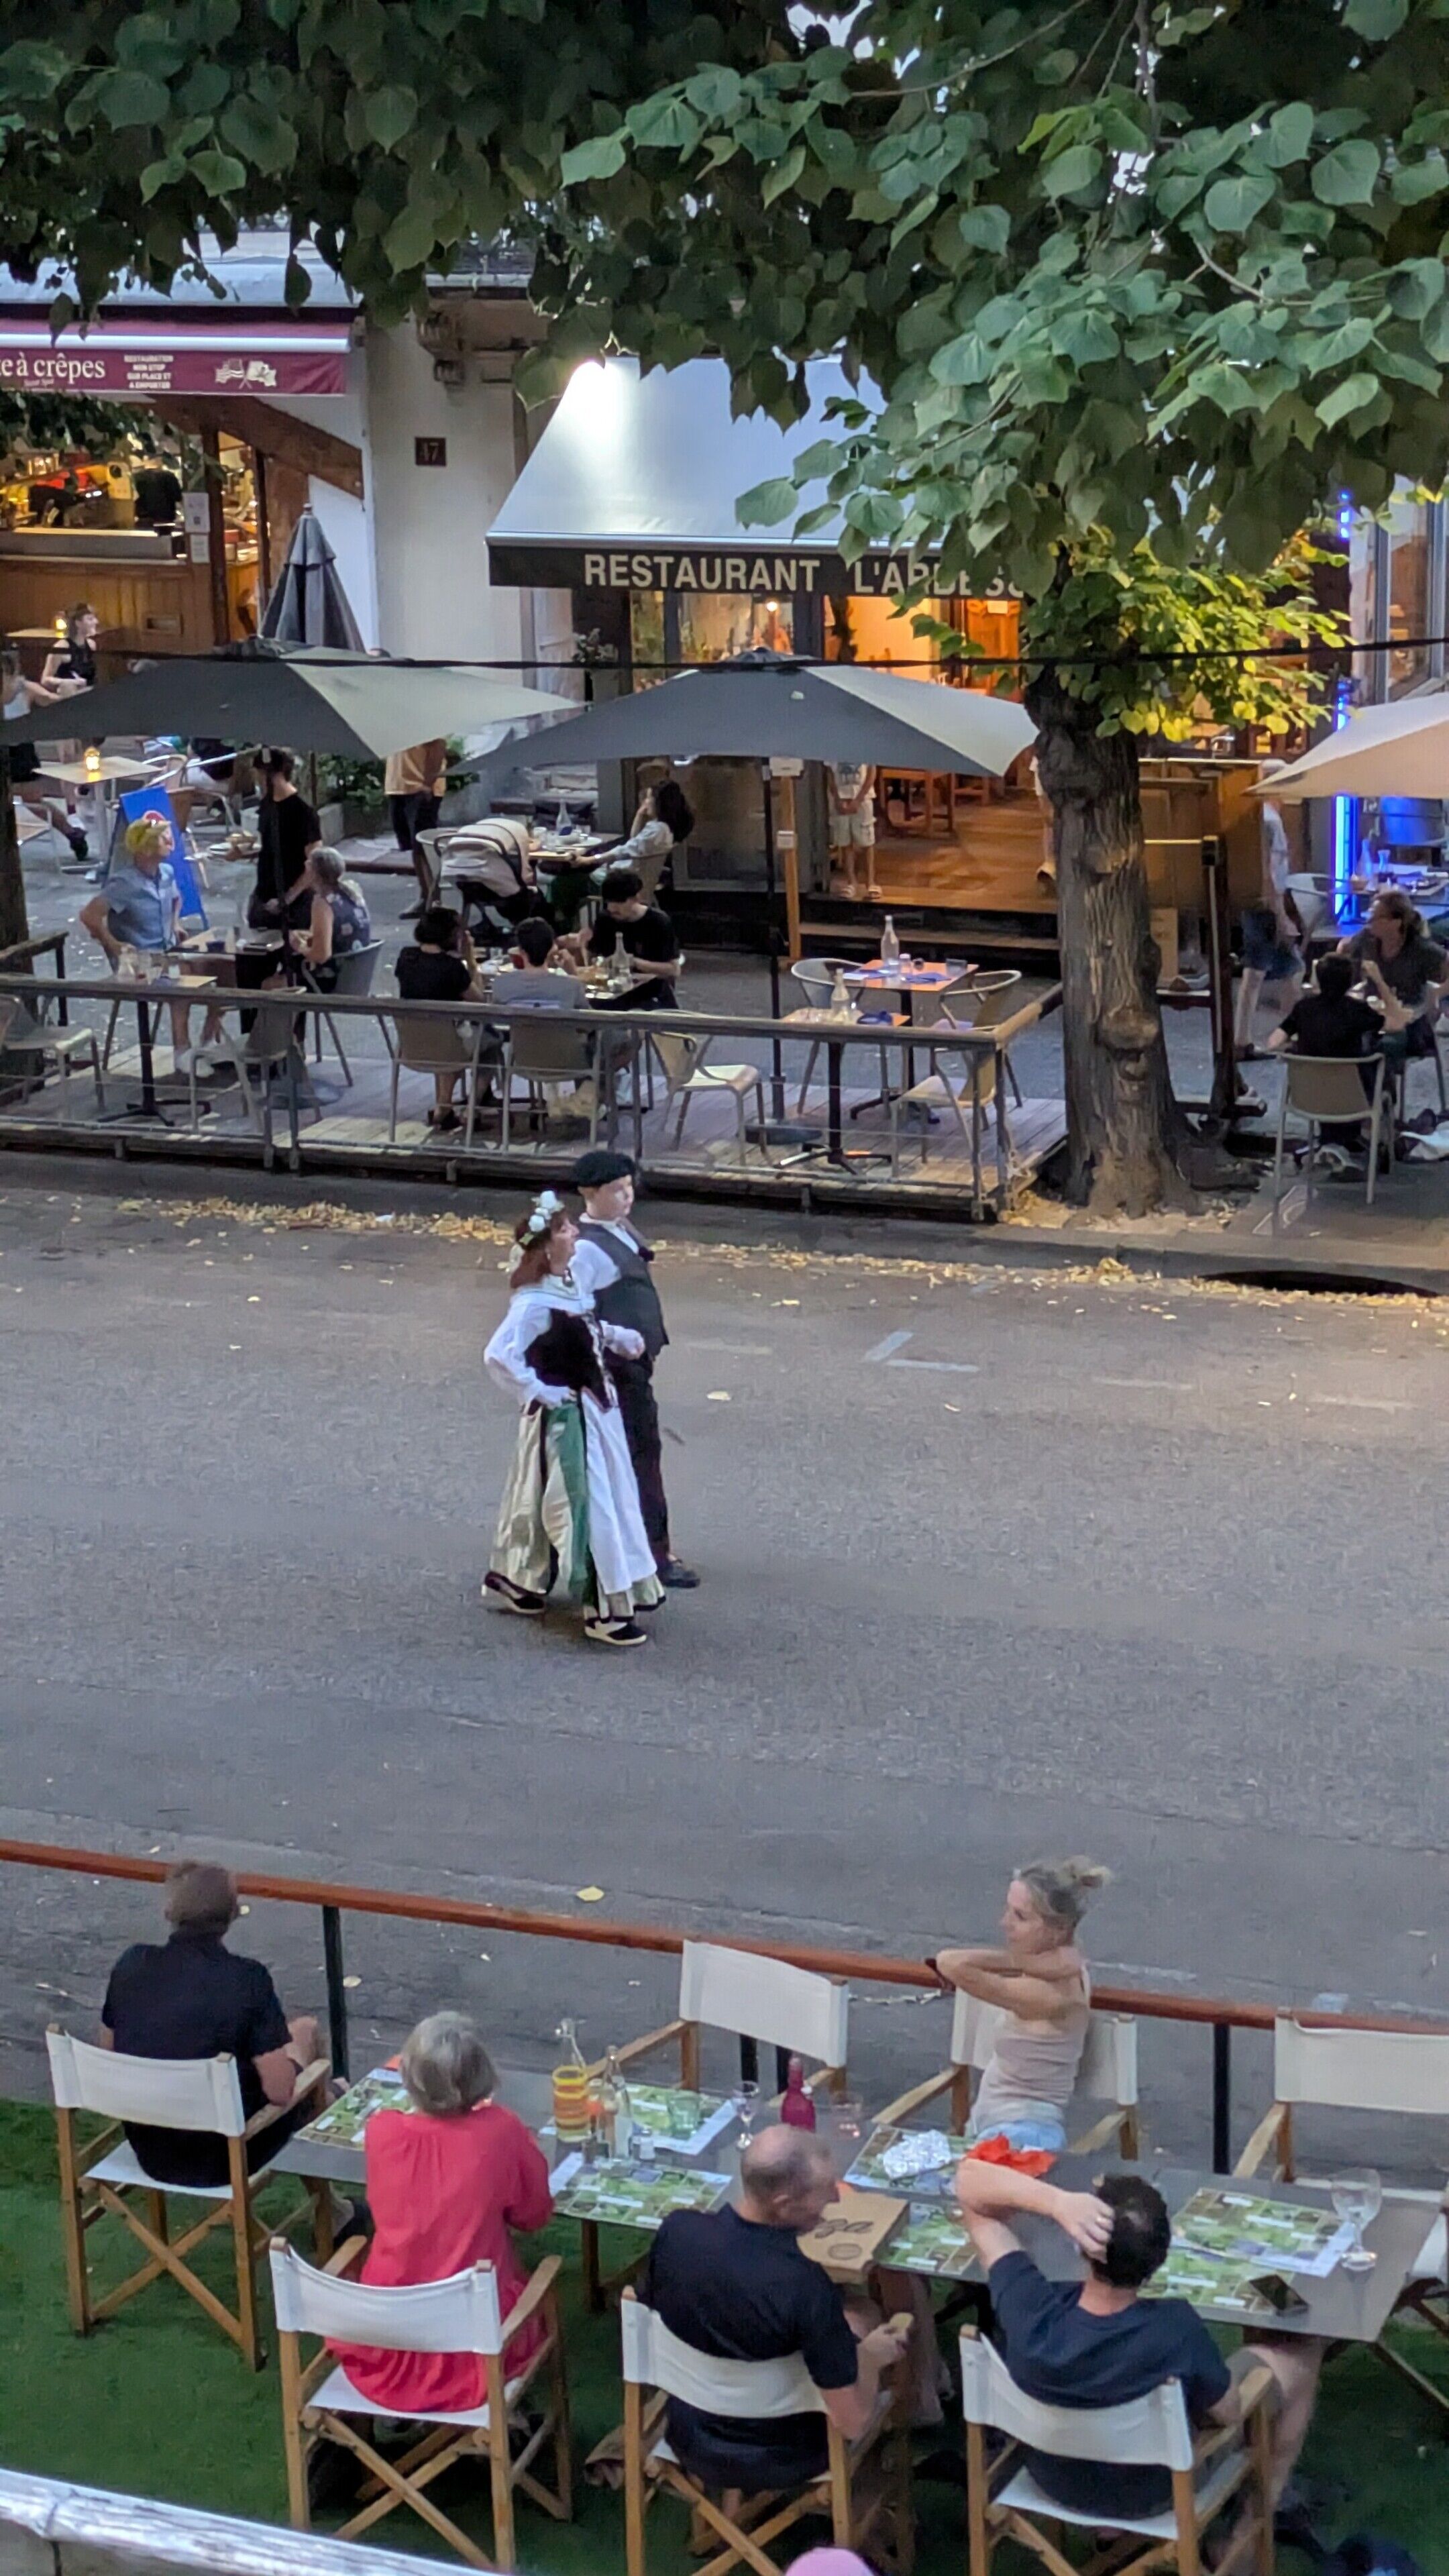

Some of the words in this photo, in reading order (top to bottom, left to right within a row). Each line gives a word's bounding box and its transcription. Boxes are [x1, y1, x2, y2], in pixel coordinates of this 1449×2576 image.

[16, 352, 29, 376] à
[34, 352, 106, 384] crêpes
[584, 554, 820, 591] RESTAURANT
